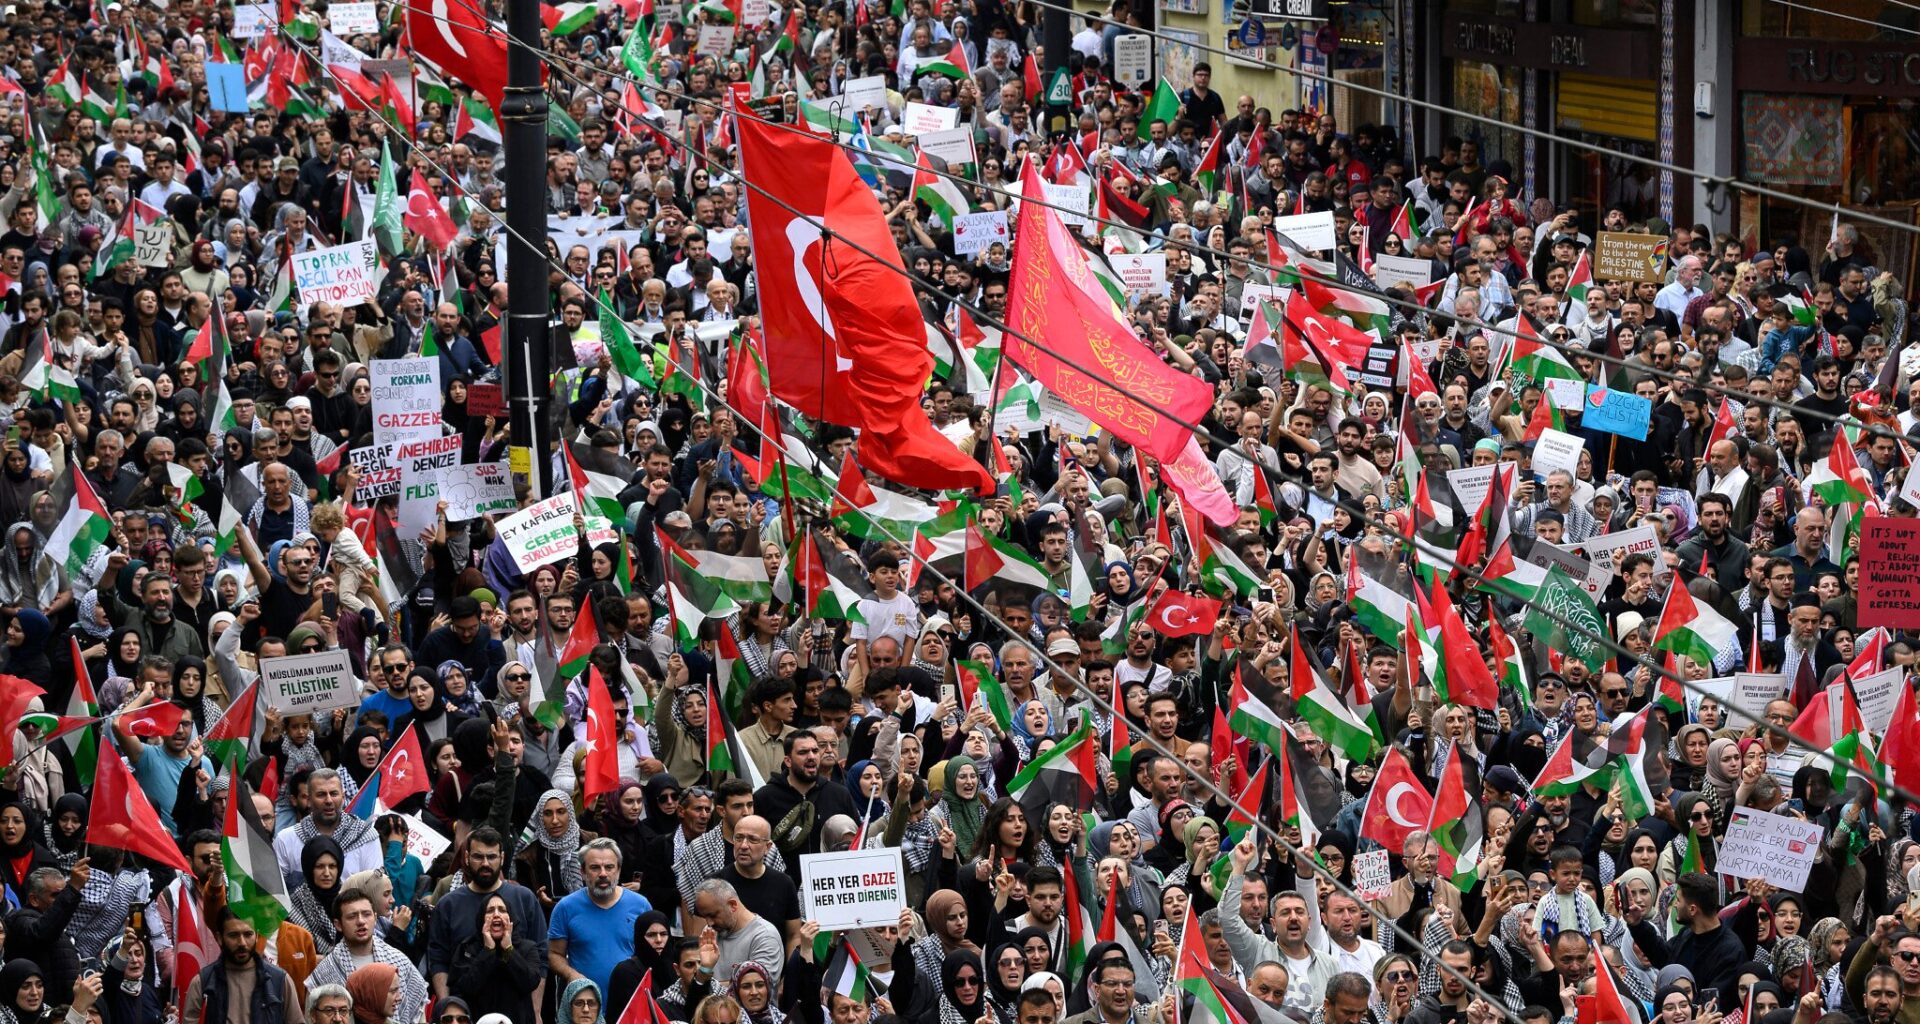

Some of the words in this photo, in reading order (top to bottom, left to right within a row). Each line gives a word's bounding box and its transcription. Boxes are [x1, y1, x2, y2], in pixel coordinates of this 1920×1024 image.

[1268, 0, 1281, 13] ICE
[1287, 0, 1312, 15] CREAM
[1551, 35, 1587, 65] IDEAL
[1787, 48, 1856, 82] RUG
[1056, 84, 1070, 97] 30
[1602, 235, 1623, 248] from
[1625, 241, 1638, 249] the
[1639, 243, 1653, 251] river
[297, 250, 352, 270] TOPRAK
[1612, 249, 1623, 257] the
[1602, 256, 1645, 269] PALESTINE
[336, 266, 362, 282] KAN
[1615, 268, 1623, 277] be
[1626, 268, 1645, 279] FREE
[391, 374, 432, 386] KORKMA
[351, 445, 393, 462] TARAF
[485, 476, 505, 486] MAK
[357, 486, 371, 500] TA
[374, 481, 401, 497] KEND
[530, 504, 546, 517] DE
[502, 527, 516, 540] EY
[1896, 530, 1915, 540] NOT
[1594, 550, 1609, 561] HER
[1628, 539, 1655, 553] GAZZE
[1878, 542, 1907, 551] ABOUT
[1888, 561, 1919, 571] ABOUT
[1877, 588, 1911, 598] GOTTA
[269, 667, 314, 679] MÜSLÜMAN
[315, 663, 344, 674] UYUMA
[280, 677, 340, 696] FİLİSTİNE
[1859, 688, 1869, 696] BİR
[291, 694, 314, 705] SAHİP
[1751, 816, 1767, 828] AZ
[1776, 823, 1807, 837] KALDI
[1721, 842, 1762, 857] ASMAYA
[1358, 856, 1382, 870] BABY
[1360, 865, 1389, 880] KILLER
[813, 877, 835, 891] HER
[838, 875, 860, 889] YER
[863, 872, 896, 886] GAZZE
[815, 895, 835, 906] HER
[837, 893, 855, 904] YER
[858, 888, 897, 902] DİRENİŞ
